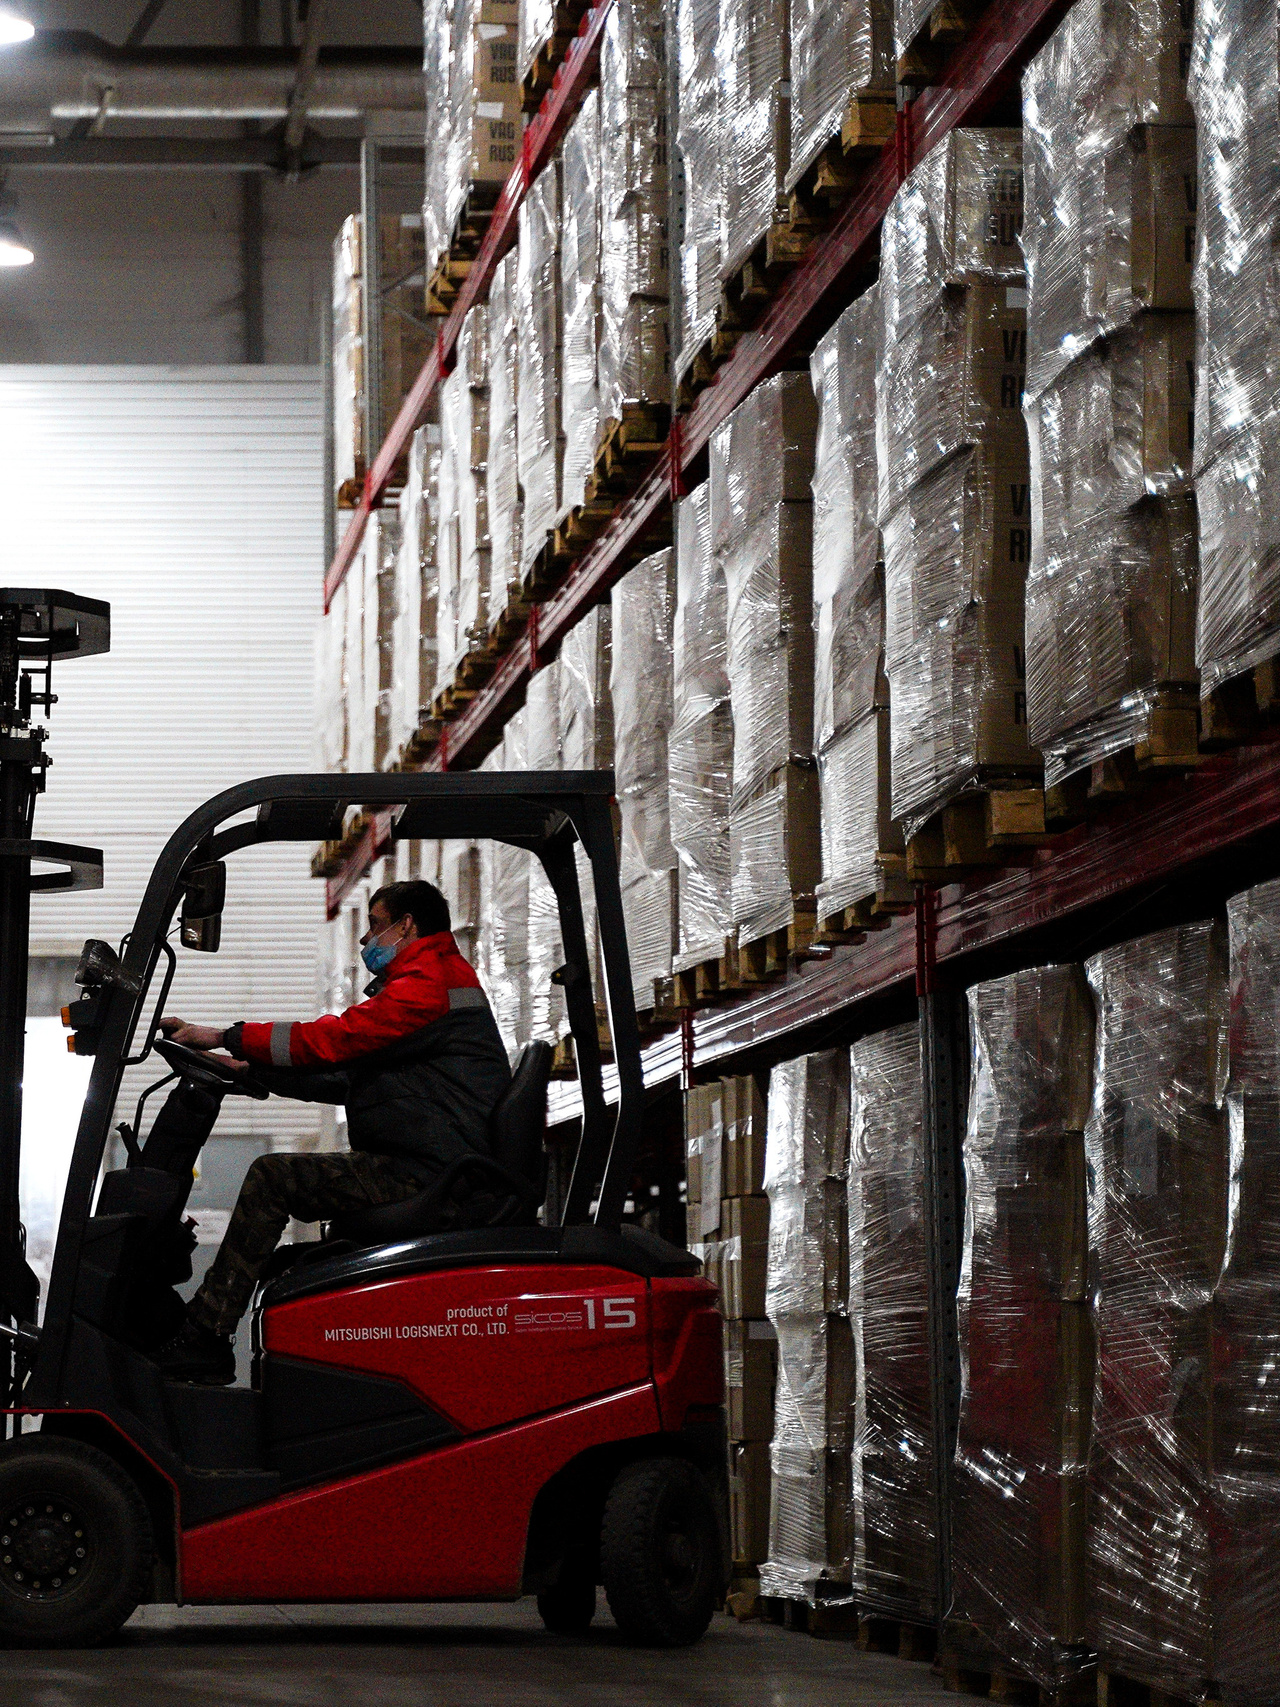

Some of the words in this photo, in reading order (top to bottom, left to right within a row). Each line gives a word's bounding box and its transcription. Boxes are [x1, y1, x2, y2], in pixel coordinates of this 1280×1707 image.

[490, 44, 516, 61] VAG
[491, 66, 516, 83] RUS
[489, 122, 515, 140] VAG
[489, 144, 515, 162] RUS
[446, 1304, 493, 1322] product
[496, 1303, 509, 1317] of
[583, 1297, 637, 1330] 15
[324, 1327, 392, 1342] MITSUBISHI
[395, 1324, 459, 1339] LOGISNEXT
[461, 1323, 484, 1338] CO.,
[487, 1322, 510, 1336] LTD.
